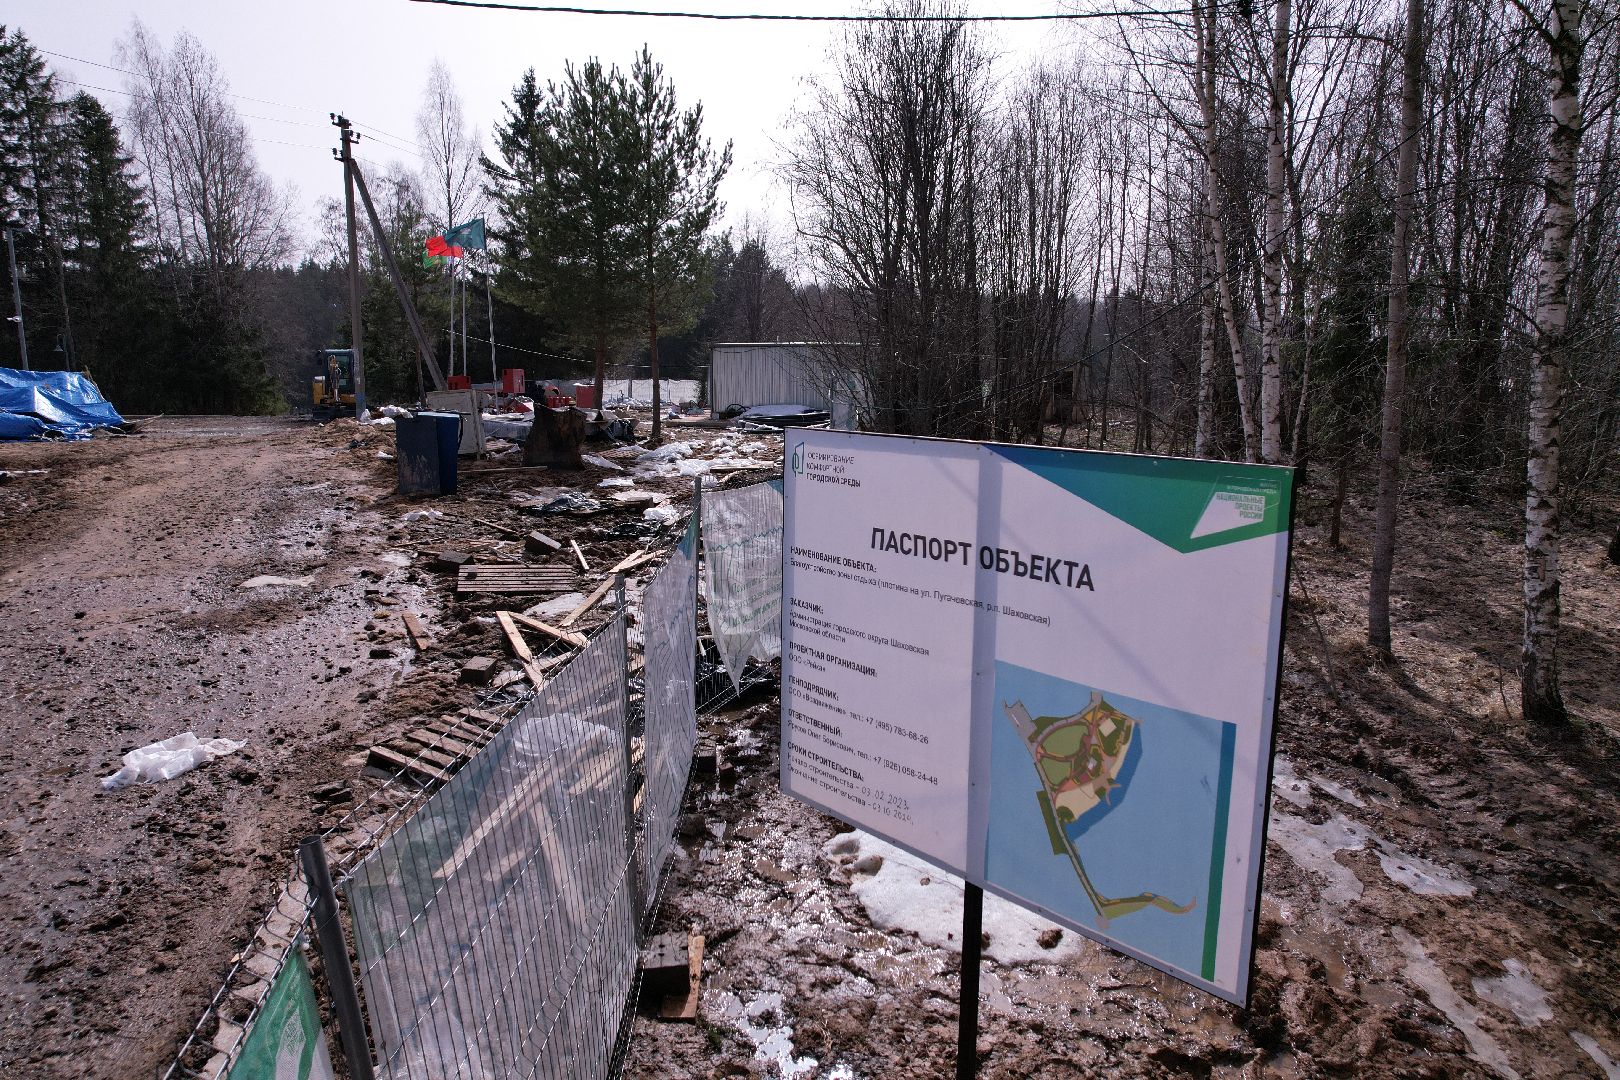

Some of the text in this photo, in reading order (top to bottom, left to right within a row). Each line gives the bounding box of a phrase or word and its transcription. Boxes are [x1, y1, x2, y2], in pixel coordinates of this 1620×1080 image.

[790, 546, 877, 573] НАИМЕНОВАНИЕ ОБЪЕКТА:
[871, 527, 1095, 591] ПАСПОРТ ОБЪЕКТА
[910, 587, 919, 595] на
[921, 589, 932, 598] ул.
[1002, 605, 1051, 627] Шаховская)
[789, 641, 878, 677] ПРОЕКТНАЯ ОРГАНИЗАЦИЯ:
[890, 638, 930, 656] Шаховская
[866, 717, 874, 725] +7
[873, 756, 882, 765] +7
